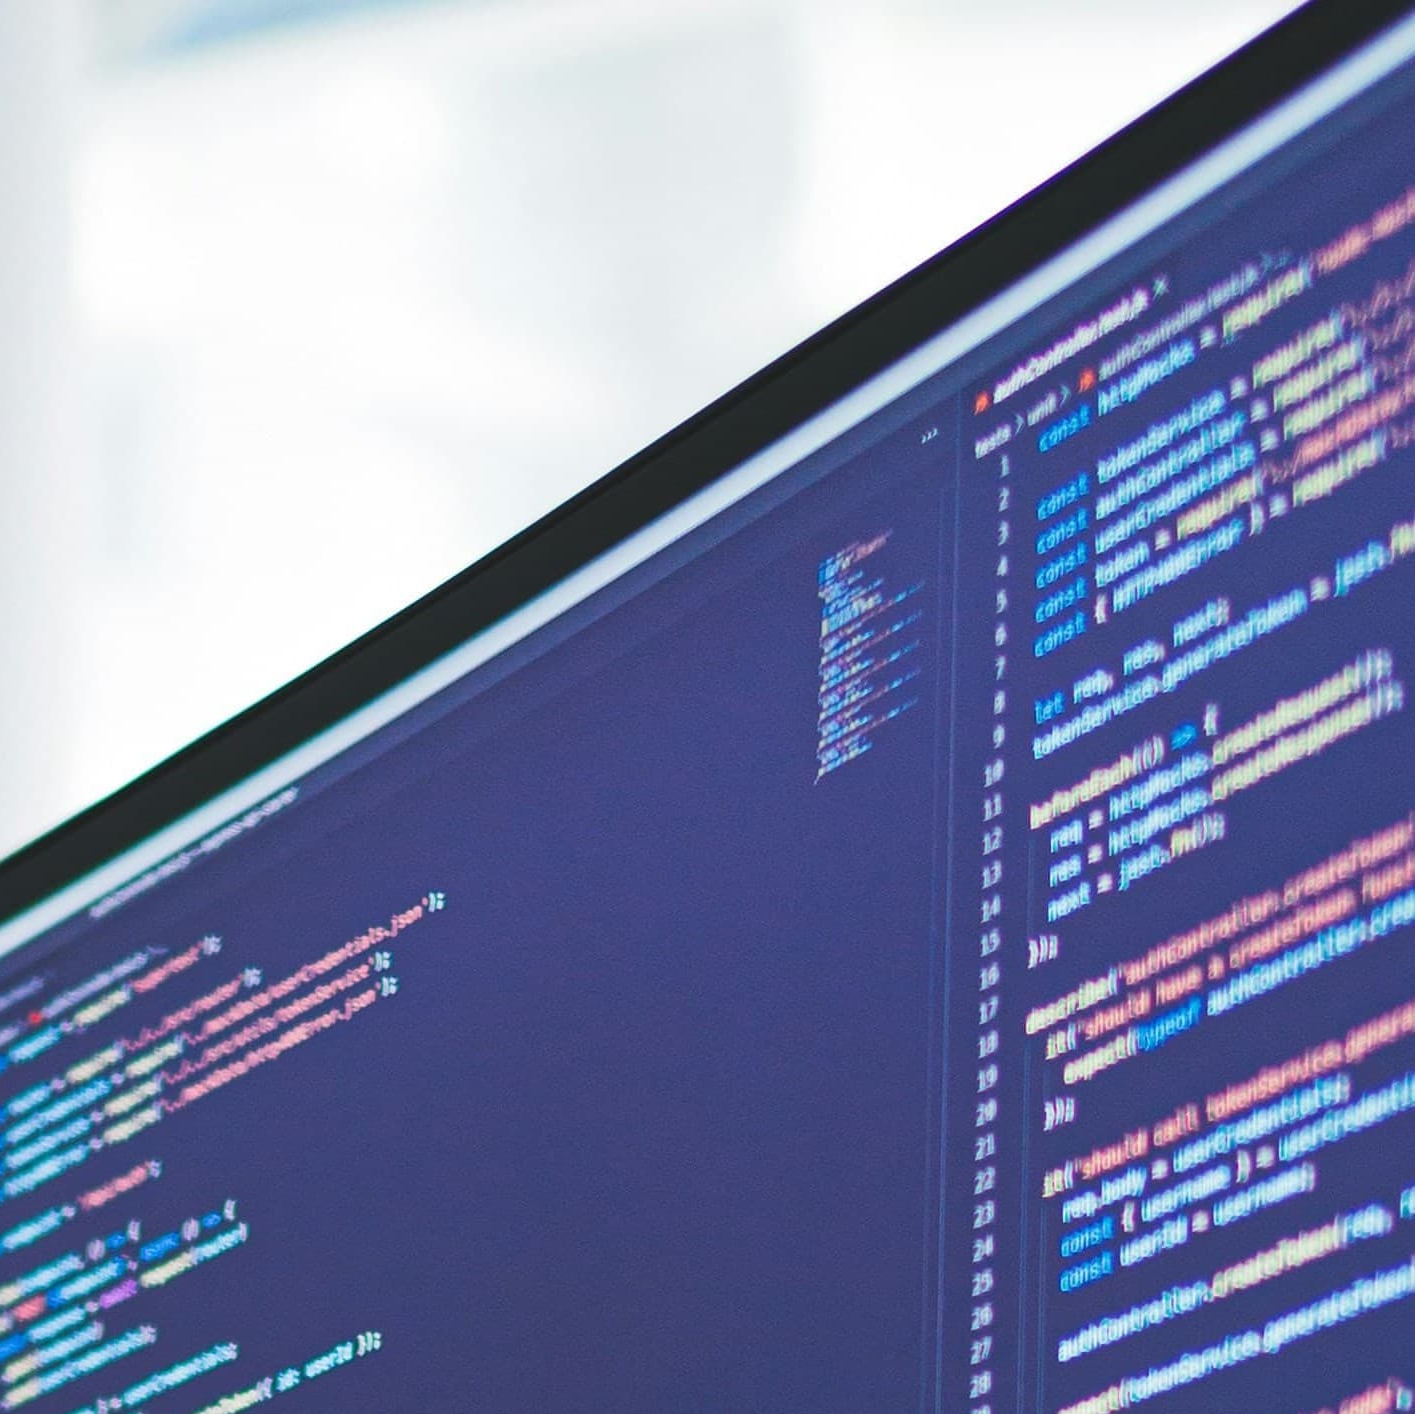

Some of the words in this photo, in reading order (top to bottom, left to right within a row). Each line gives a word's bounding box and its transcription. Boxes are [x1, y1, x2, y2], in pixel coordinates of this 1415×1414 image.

[999, 452, 1009, 476] 1
[1040, 400, 1091, 450] const
[1038, 469, 1089, 518] const
[997, 554, 1007, 577] 4
[1038, 503, 1089, 553] const
[1037, 538, 1088, 587] const
[995, 621, 1006, 645] 6
[1036, 573, 1087, 621] const
[1035, 607, 1086, 655] const
[993, 723, 1003, 747] 9
[1034, 688, 1065, 724] let
[981, 825, 1001, 854] 12
[979, 893, 999, 921] 14
[978, 961, 998, 989] 16
[976, 1063, 996, 1091] 19
[1156, 966, 1201, 1003] have
[974, 1131, 994, 1159] 21
[1153, 1104, 1198, 1144] call
[972, 1234, 992, 1260] 24
[1061, 1213, 1113, 1255] const
[970, 1302, 990, 1328] 26
[1060, 1248, 1112, 1290] const
